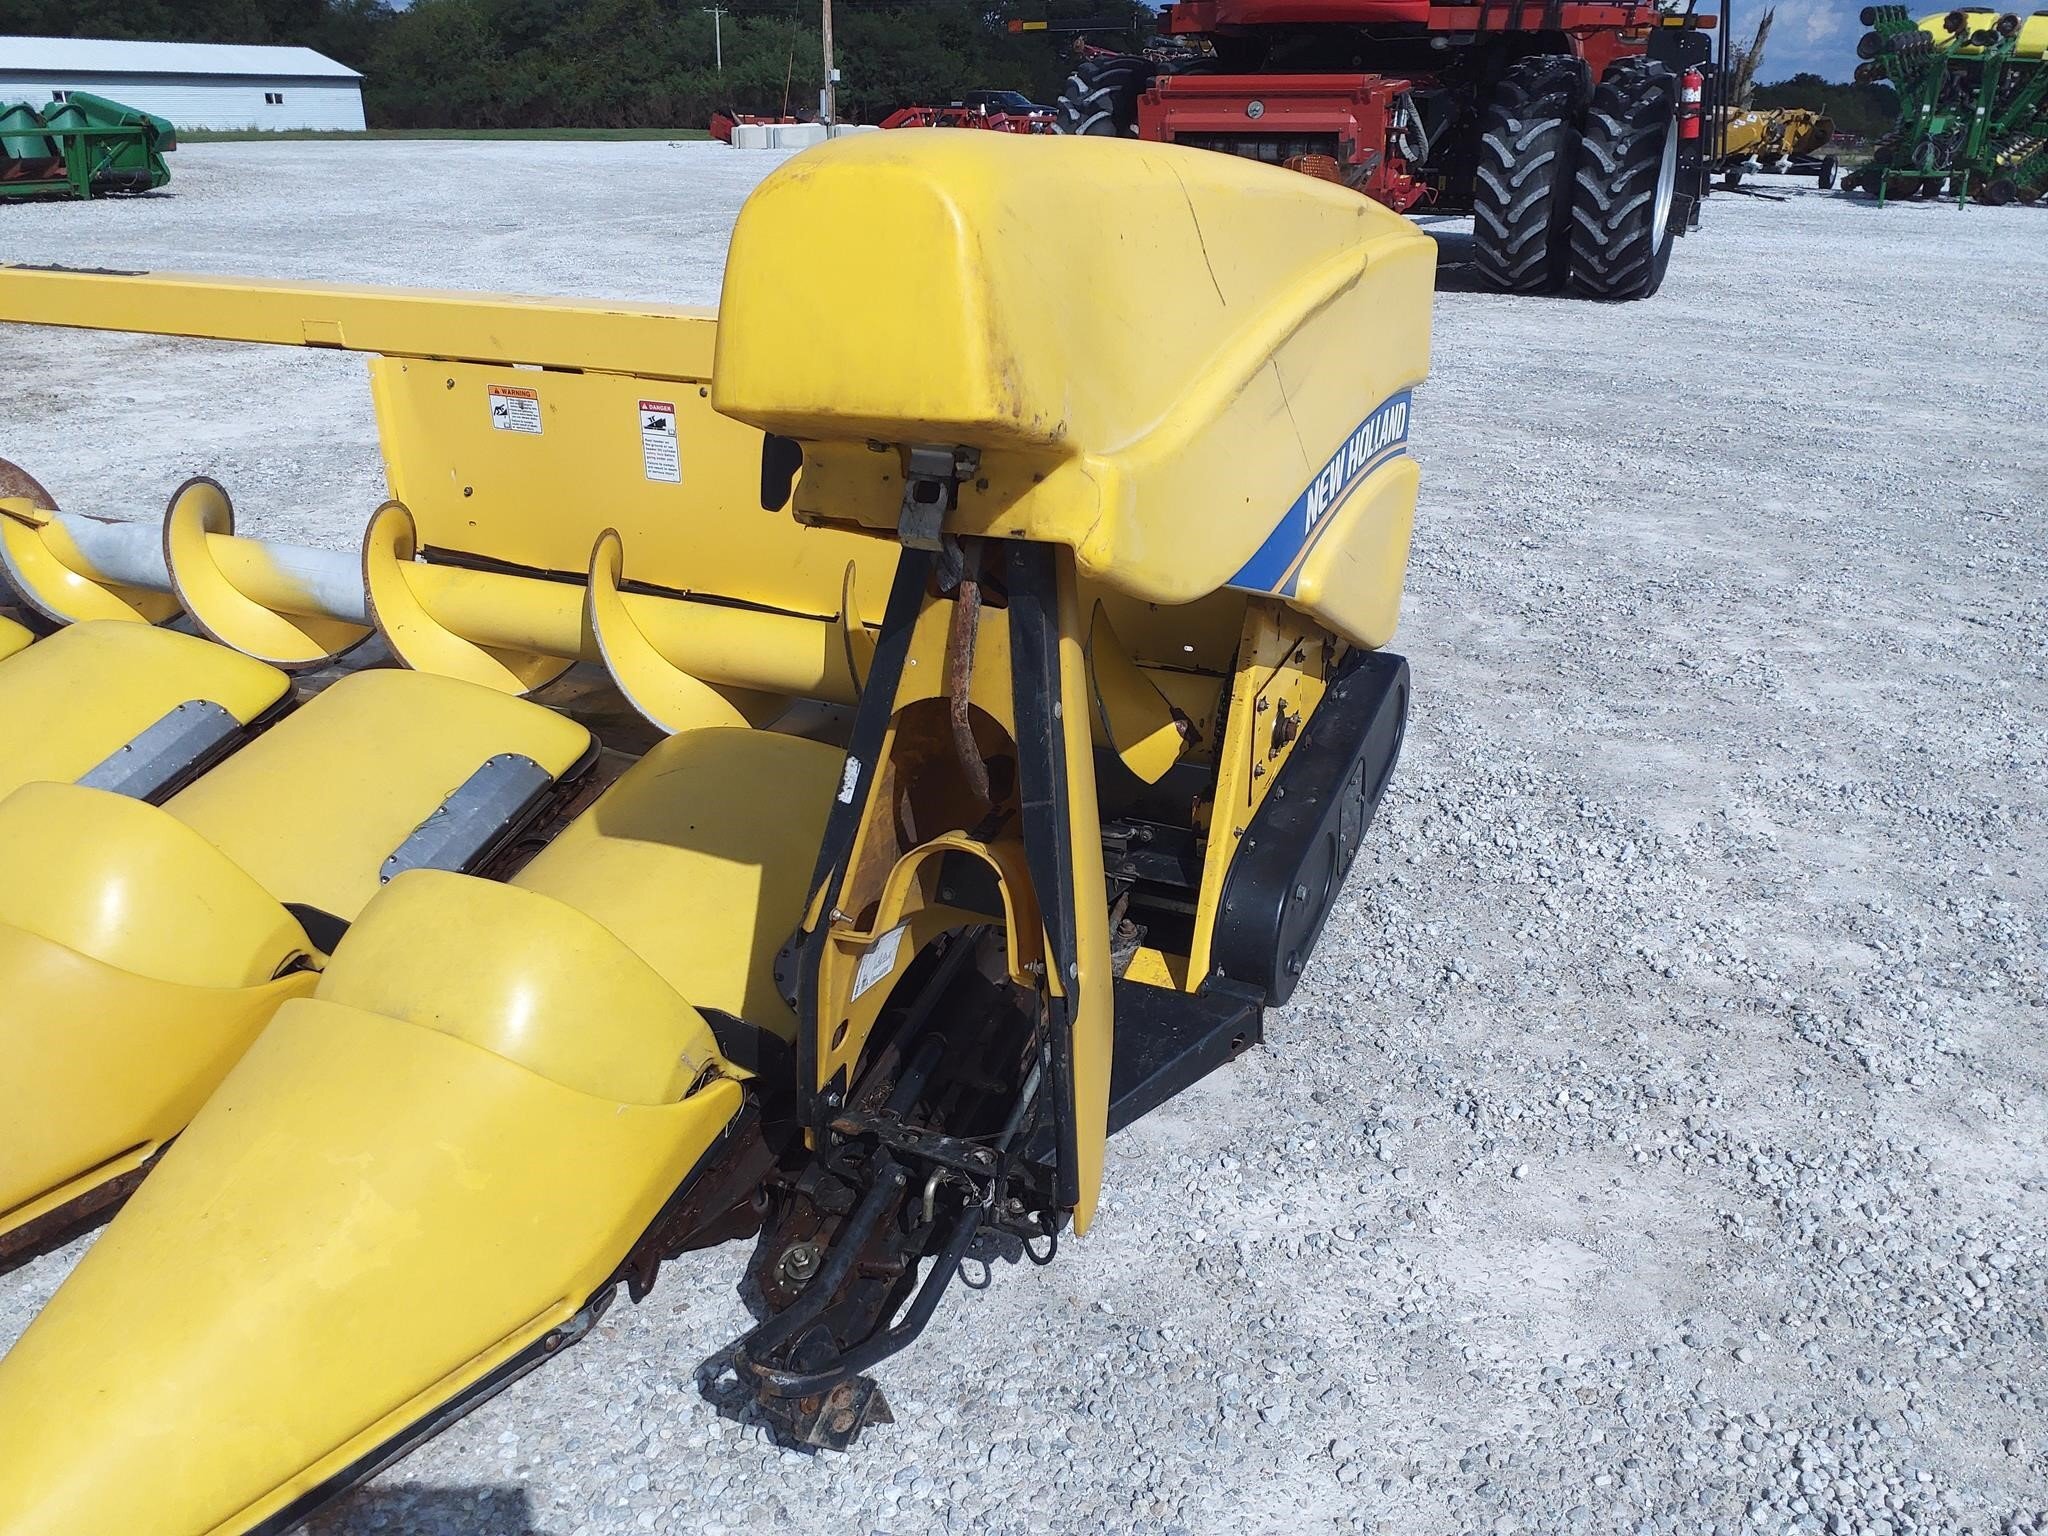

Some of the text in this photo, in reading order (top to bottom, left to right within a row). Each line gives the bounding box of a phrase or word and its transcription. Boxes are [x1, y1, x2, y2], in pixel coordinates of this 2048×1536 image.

[502, 389, 531, 397] WARNING
[649, 404, 672, 412] DANGER
[1304, 401, 1407, 537] NEW HOLLAND
